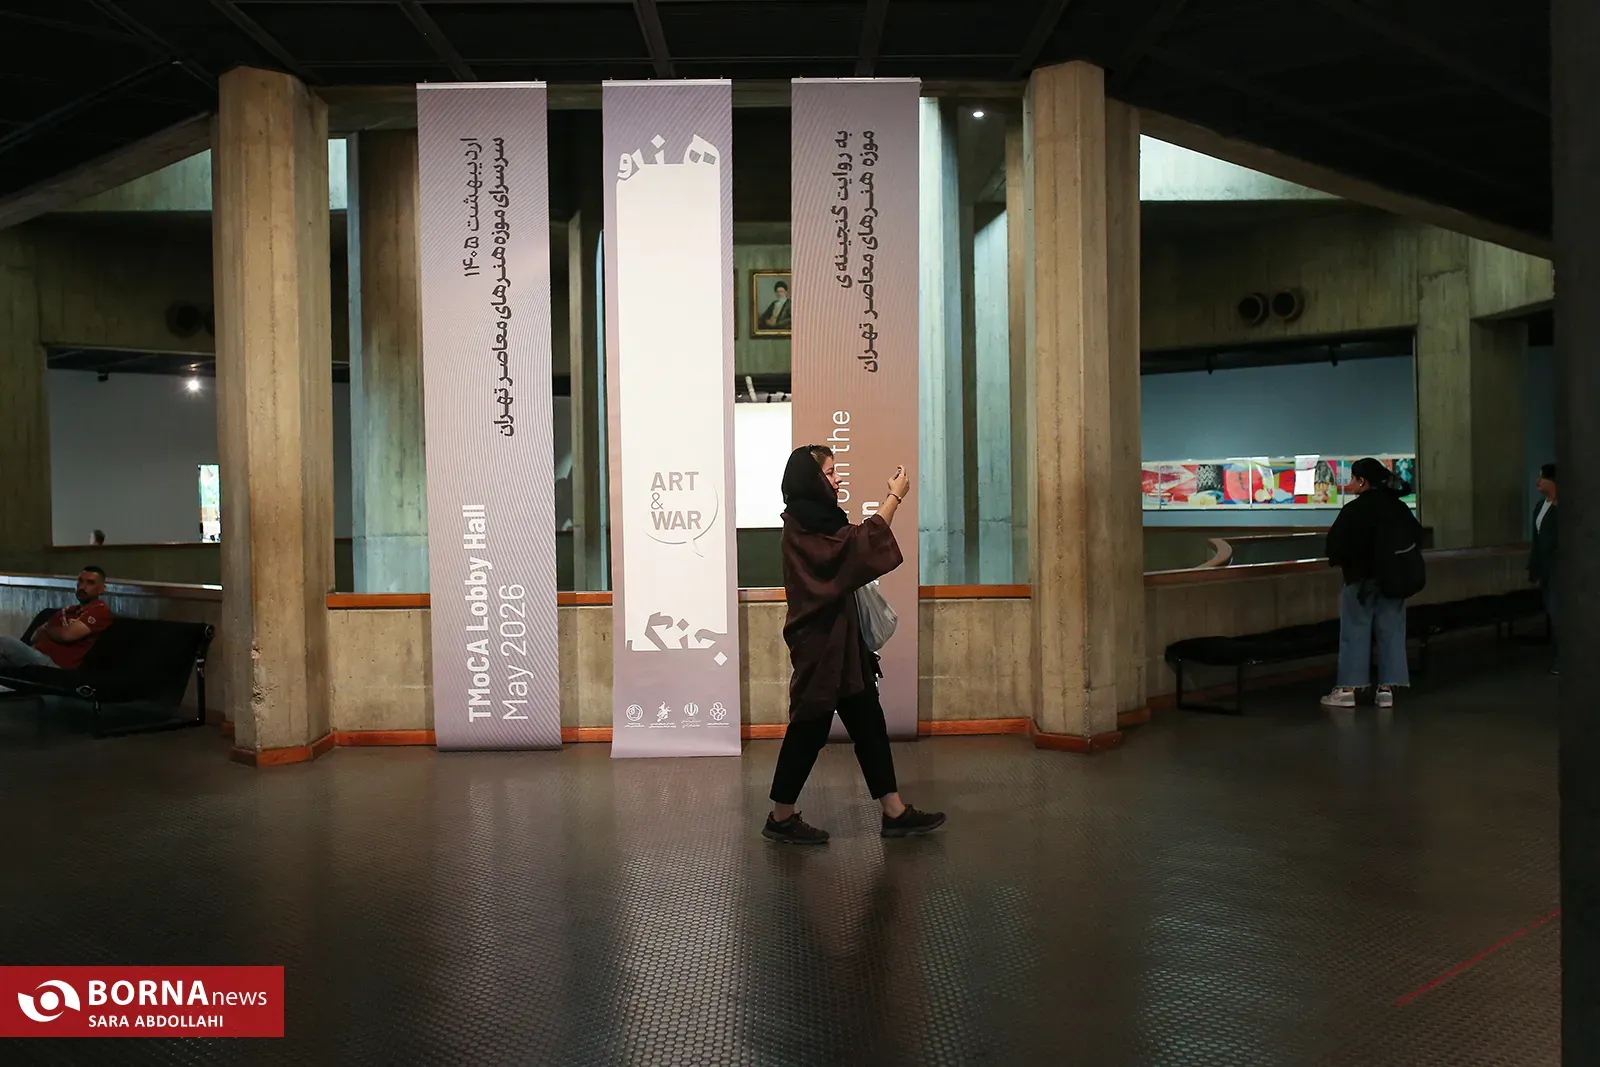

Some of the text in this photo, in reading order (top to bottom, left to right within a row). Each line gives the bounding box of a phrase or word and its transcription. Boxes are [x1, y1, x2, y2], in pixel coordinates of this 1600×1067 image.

[834, 130, 853, 148] به
[832, 152, 853, 201] روایت
[460, 137, 483, 276] اردیبهشت ۱۴۰۵
[857, 130, 879, 373] موزه هنرهای معاصر تهران
[488, 137, 515, 436] سرسرای موزه هنرهای معاصر تهران
[827, 410, 851, 454] the
[650, 471, 699, 491] ART
[650, 492, 664, 510] &
[650, 510, 702, 530] WAR
[462, 504, 493, 723] TMoCA Lobby Hall
[498, 583, 534, 720] May 2026
